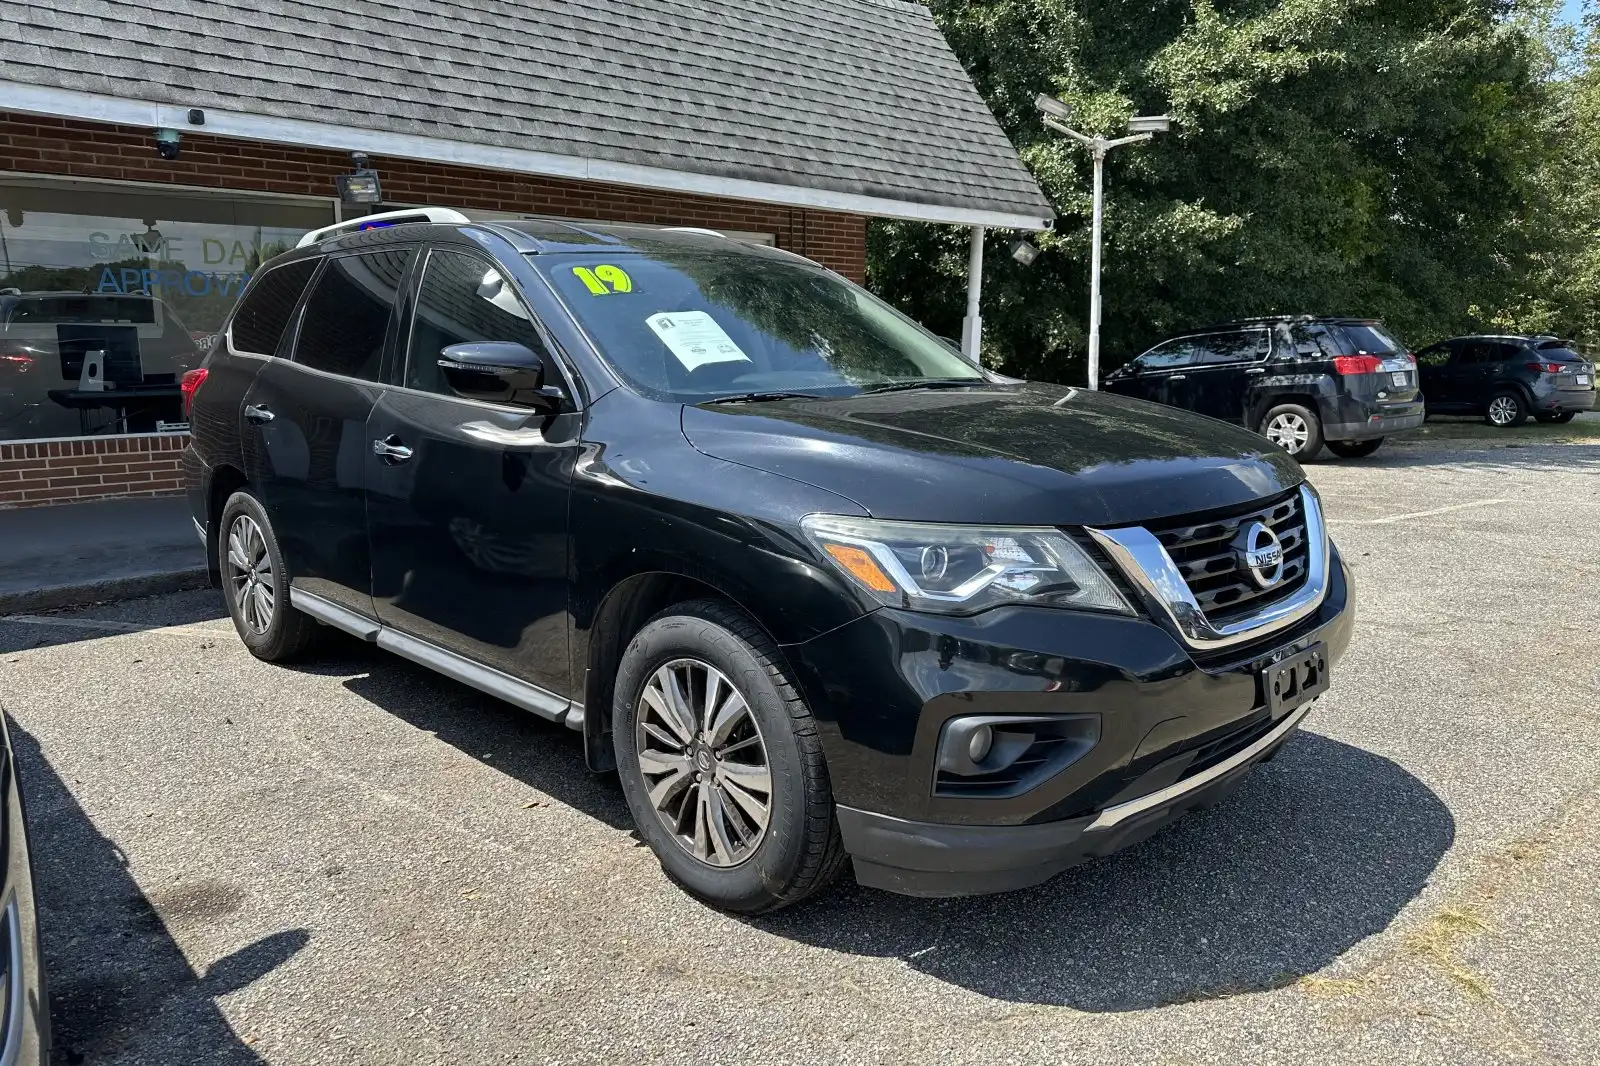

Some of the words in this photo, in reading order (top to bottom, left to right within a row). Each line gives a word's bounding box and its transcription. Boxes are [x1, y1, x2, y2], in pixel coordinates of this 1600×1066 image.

[88, 231, 184, 264] SAME
[203, 238, 270, 266] DAY
[572, 265, 632, 295] 19
